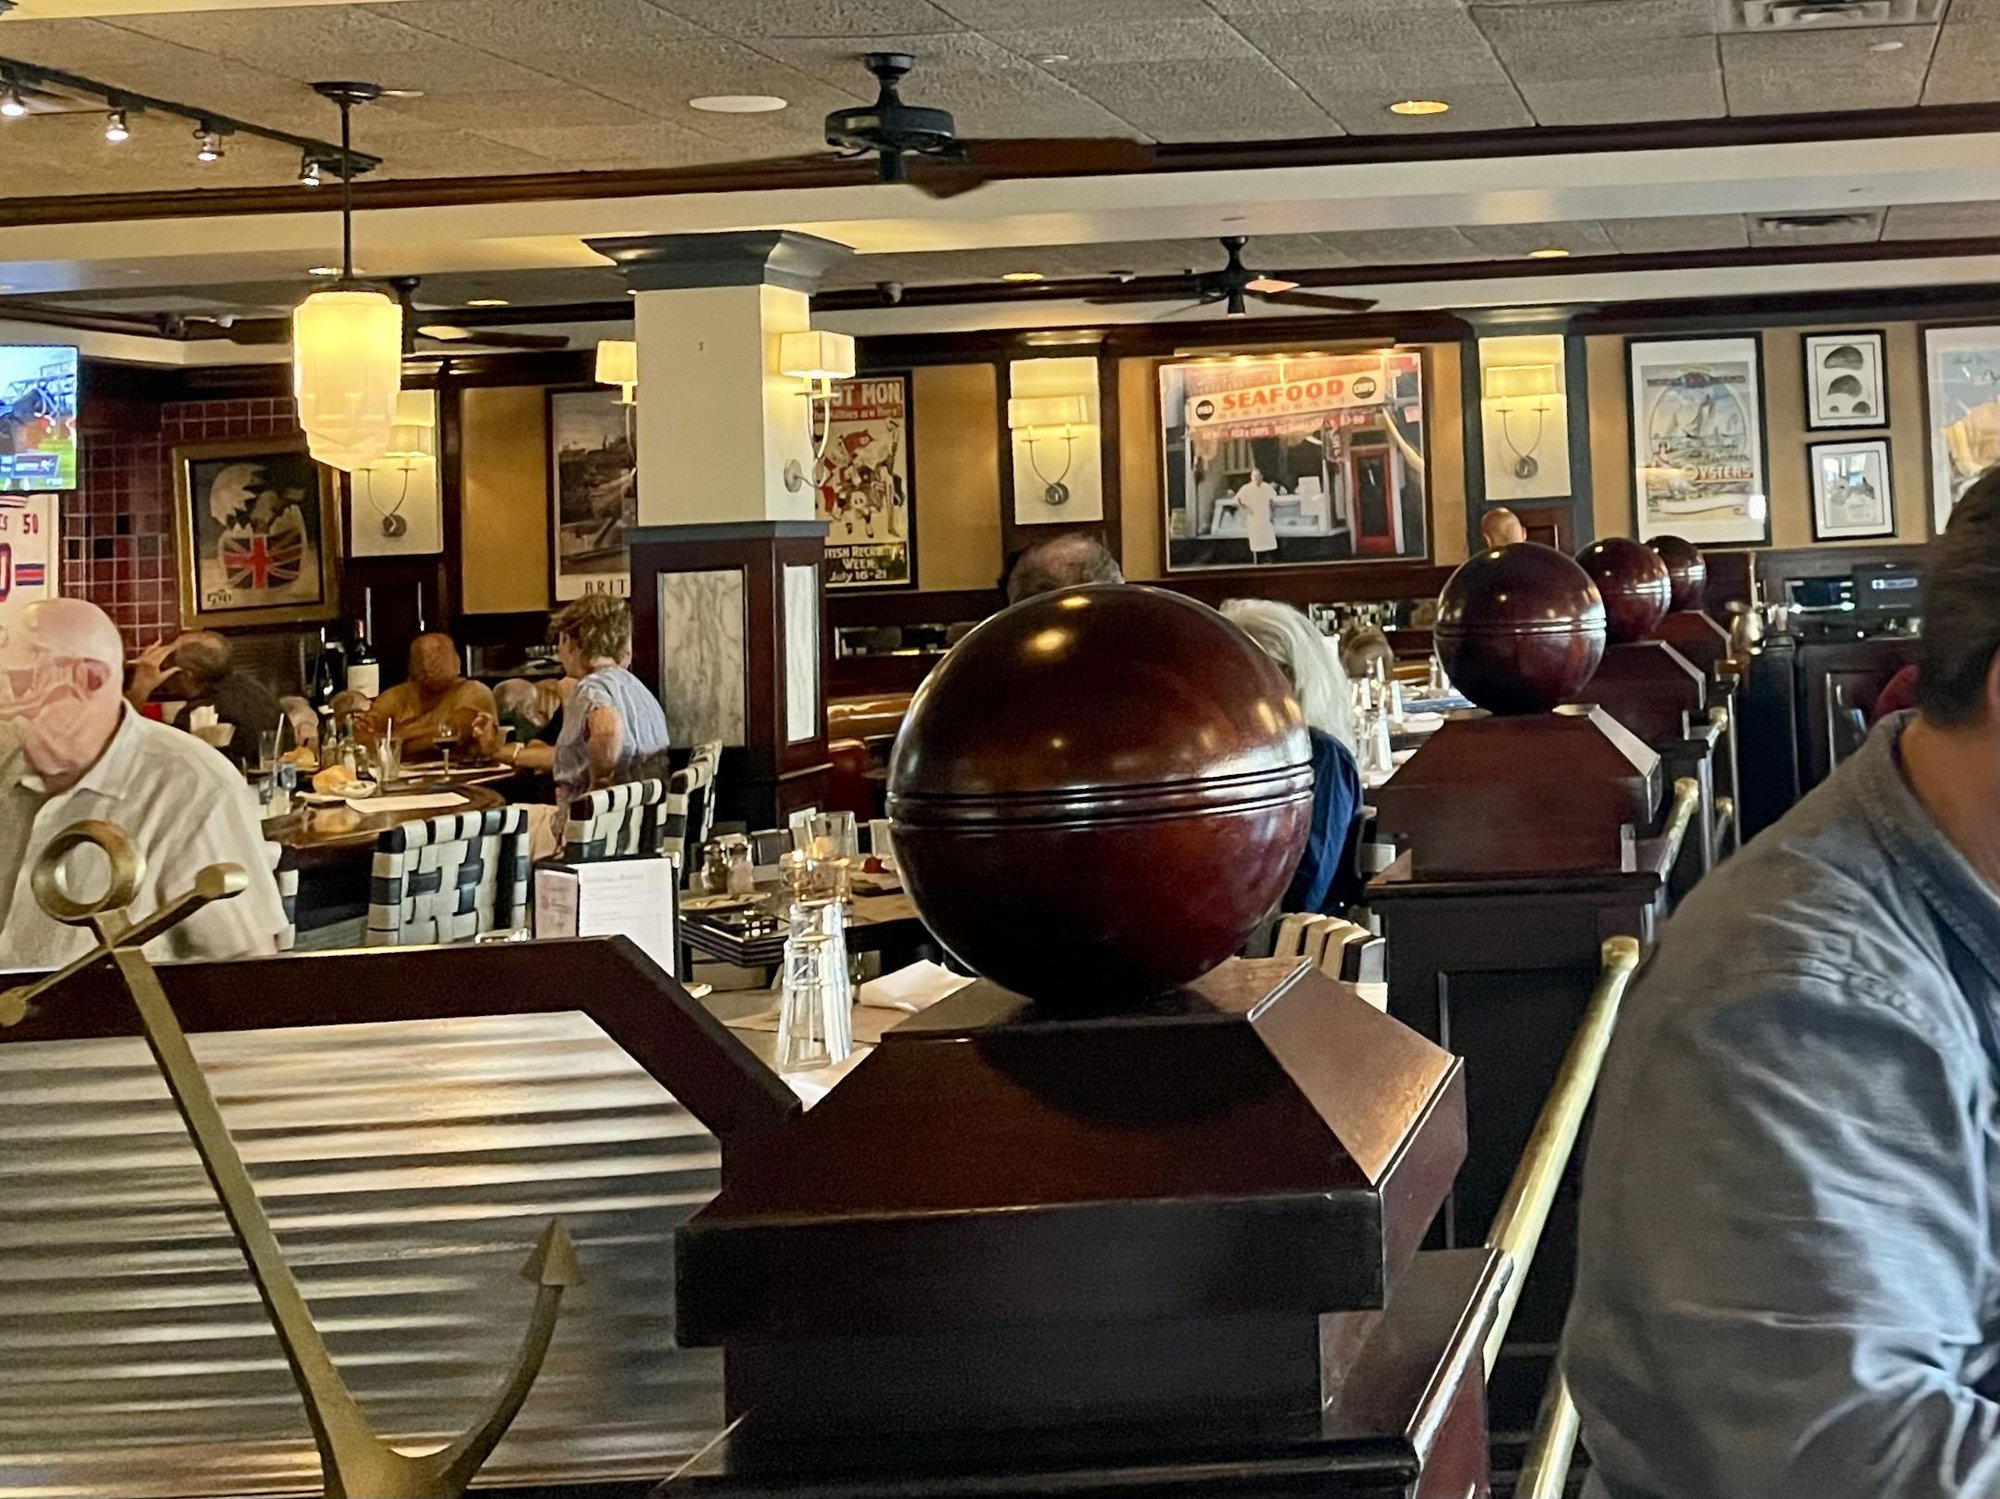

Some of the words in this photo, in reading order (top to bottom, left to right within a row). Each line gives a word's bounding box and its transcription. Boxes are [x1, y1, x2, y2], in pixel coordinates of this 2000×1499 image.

[861, 382, 901, 405] MON
[1221, 379, 1344, 411] SEAFOOD
[1683, 465, 1753, 480] OYSTERS
[23, 514, 38, 534] 50
